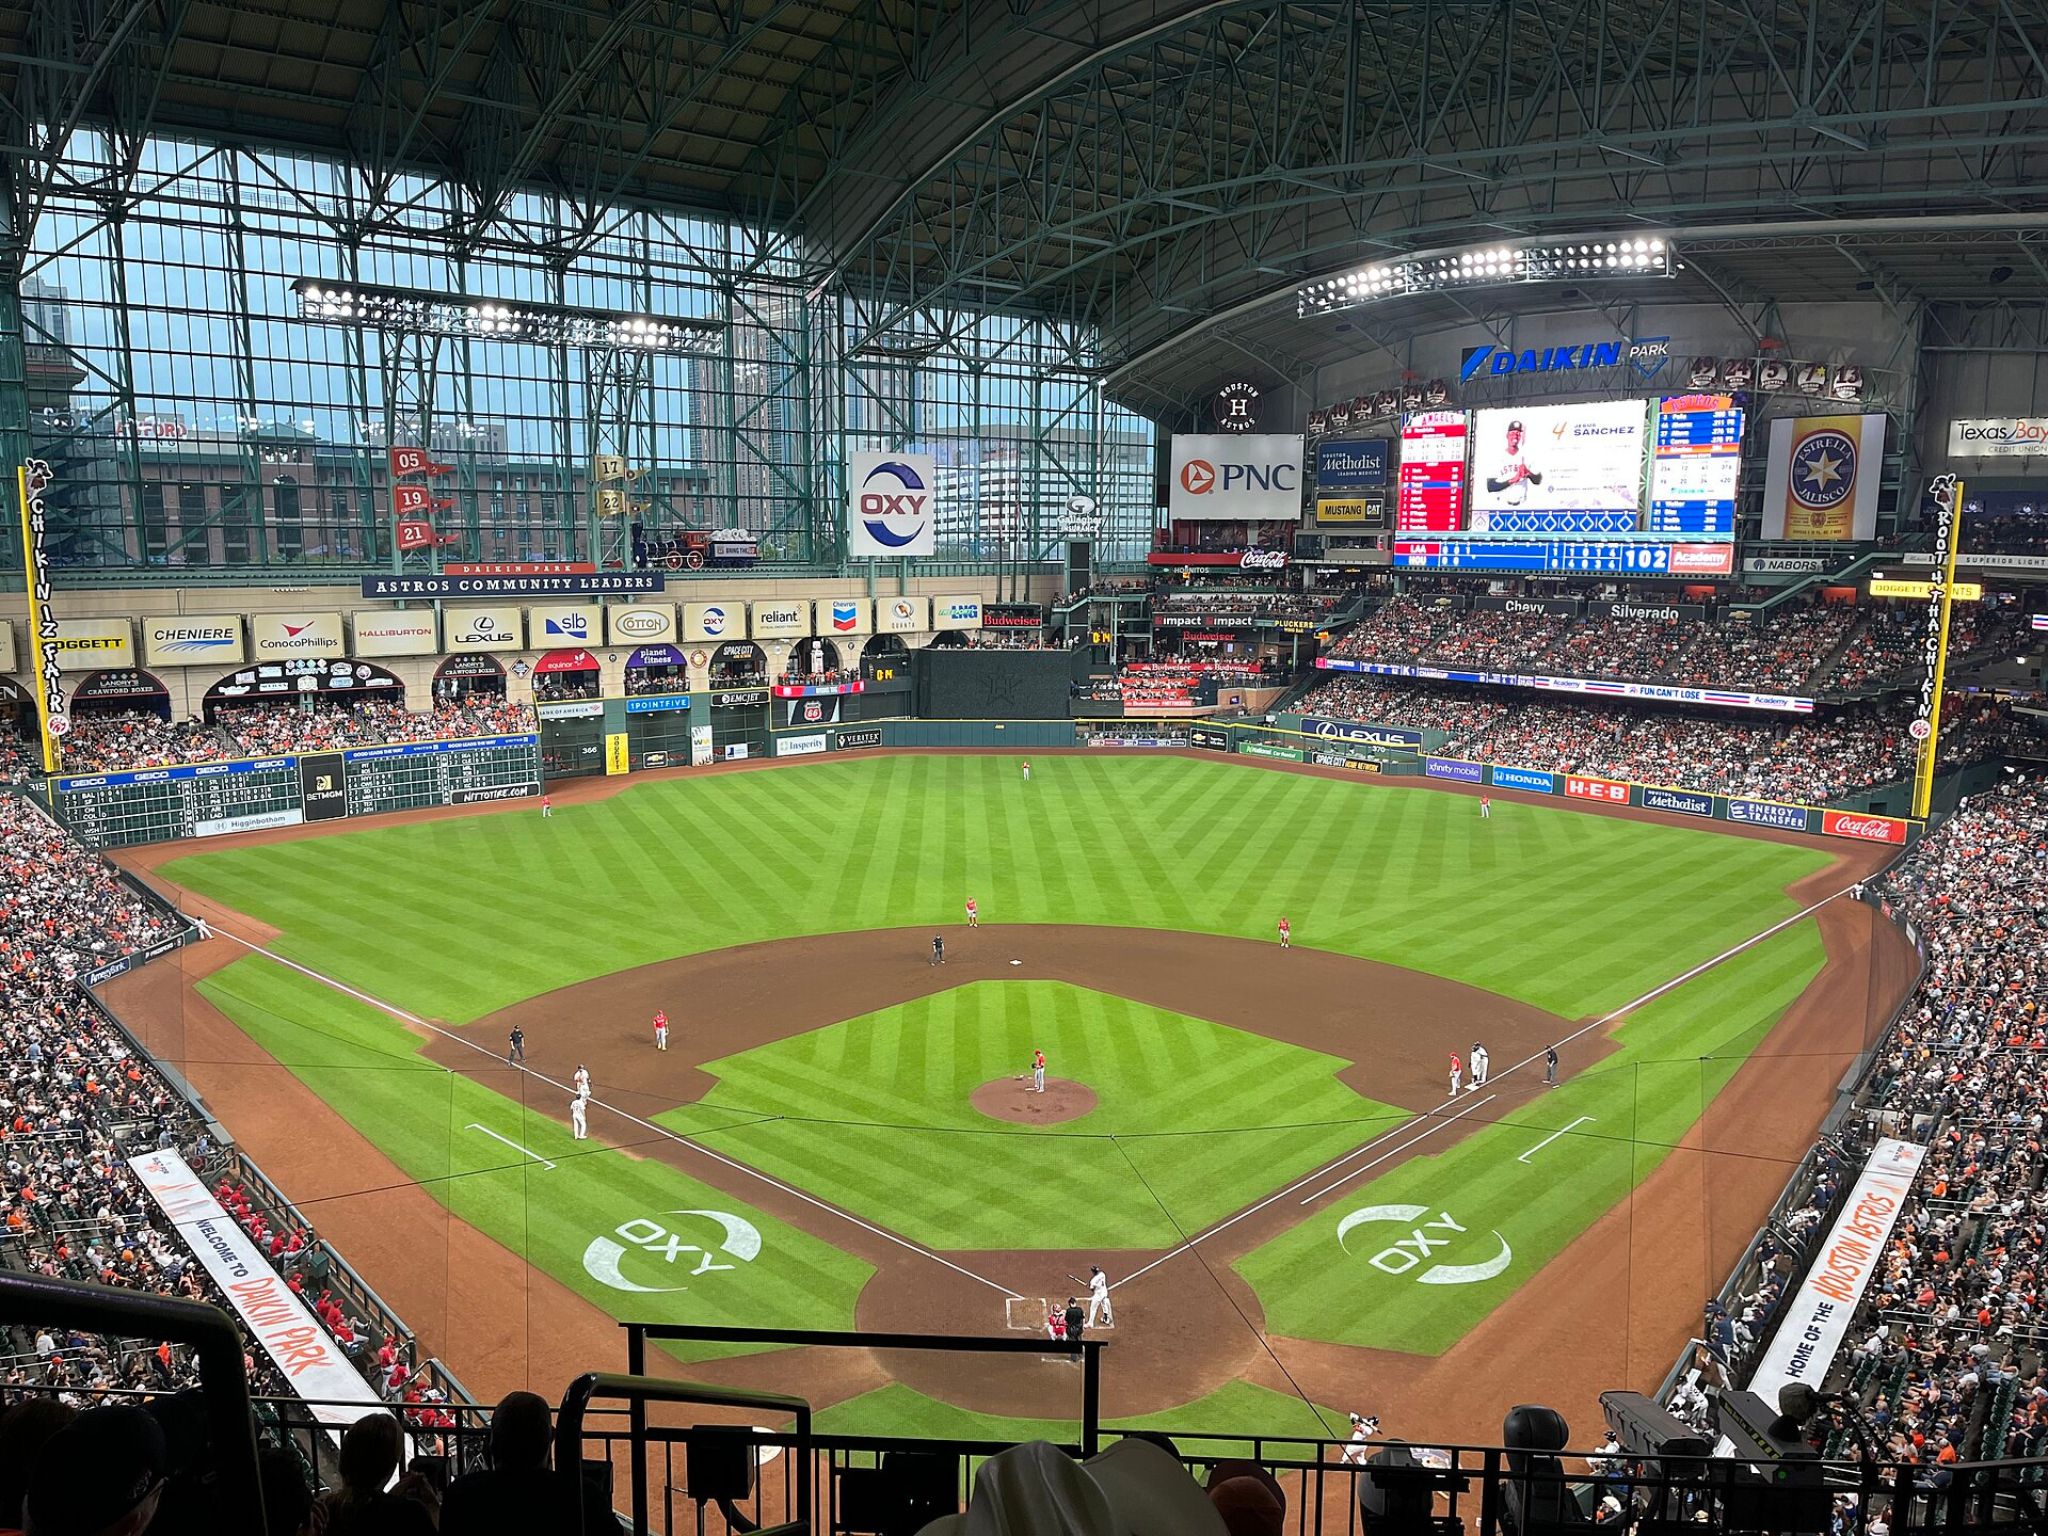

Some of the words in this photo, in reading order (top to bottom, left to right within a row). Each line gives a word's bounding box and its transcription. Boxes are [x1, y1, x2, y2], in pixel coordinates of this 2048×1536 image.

[1490, 342, 1622, 374] DAIKIN
[1630, 343, 1669, 358] PARK
[1725, 358, 1749, 374] 24
[1767, 360, 1779, 378] 5
[1838, 365, 1859, 383] 13
[1220, 382, 1259, 398] HOUSTON
[1377, 390, 1394, 404] 33
[1403, 384, 1420, 399] 34
[1230, 399, 1248, 416] H
[1354, 397, 1370, 411] 25
[1671, 397, 1719, 412] ASTROS
[1220, 417, 1256, 431] ASTROS
[1309, 410, 1324, 425] 32
[1421, 413, 1455, 426] ANGELS
[1552, 421, 1568, 440] 4
[1573, 426, 1635, 436] SANCHEZ
[1958, 423, 2008, 440] Texas
[2016, 422, 2048, 443] Bay
[1798, 438, 1852, 461] ESTRELLA
[399, 453, 419, 468] 05
[602, 461, 618, 474] 17
[1322, 454, 1381, 471] Methodist
[1220, 463, 1296, 491] PNC
[402, 491, 421, 505] 19
[1799, 486, 1845, 502] JALISCO
[603, 497, 619, 509] 22
[860, 494, 927, 515] OXY
[1324, 505, 1362, 515] MUSTANG
[1366, 504, 1380, 515] CAT
[1057, 514, 1102, 525] Gallagher
[404, 526, 423, 541] 21
[1935, 511, 1951, 564] ROOT
[1410, 545, 1426, 554] LAA
[1240, 550, 1288, 569] Coca-Cola
[1409, 556, 1427, 565] HOU
[1673, 552, 1727, 566] Academy
[1768, 560, 1817, 570] NABORS
[463, 565, 522, 573] DAIKIN
[1932, 570, 1943, 584] 4
[376, 580, 450, 593] ASTROS
[460, 578, 572, 591] COMMUNITY
[580, 577, 653, 589] LEADERS
[1875, 585, 1923, 593] DOGGETT
[761, 610, 798, 624] reliant
[951, 604, 978, 620] LNG
[1505, 600, 1545, 615] Chevy
[1611, 605, 1679, 620] Silverado
[1928, 590, 1942, 632] THA
[562, 613, 587, 629] slb
[622, 617, 662, 631] COTTON
[984, 615, 1041, 626] Budweiser
[1163, 616, 1202, 627] impact
[1213, 616, 1252, 627] impact
[1274, 620, 1314, 629] PLUCKERS
[155, 628, 233, 641] CHENIERE
[359, 629, 432, 637] HALLIBURTON
[455, 633, 513, 643] LEXUS
[1183, 632, 1236, 641] Budweiser
[260, 638, 338, 649] ConocoPhillips
[723, 646, 743, 656] SPACE
[741, 645, 754, 654] CITY
[640, 649, 667, 659] planet
[644, 655, 672, 664] fitness
[445, 668, 477, 676] CRAWFORD
[1152, 663, 1191, 671] Budweiser
[1214, 663, 1250, 672] Budweiser
[44, 643, 63, 712] FAIR
[99, 679, 139, 687] LANDRY'S
[1918, 637, 1938, 717] CHIKIN
[87, 687, 128, 696] CRAWFORD
[131, 686, 154, 694] BOXES
[730, 692, 760, 703] EMCJET
[1553, 679, 1580, 688] Academy
[1640, 687, 1655, 696] FUN
[1657, 688, 1680, 697] CAN'T
[1680, 689, 1700, 699] LOSE
[1754, 696, 1788, 707] Academy
[563, 707, 589, 715] AMERICA
[630, 698, 686, 710] 1POINTFIVE
[807, 709, 819, 718] 66
[847, 733, 879, 742] VERITEX
[1340, 729, 1405, 744] LEXUS
[789, 737, 823, 751] Insperity
[254, 760, 286, 769] GEICO
[1316, 754, 1333, 766] SPACE
[1331, 756, 1346, 767] CITY
[134, 771, 170, 781] GEICO
[195, 766, 229, 775] GEICO
[1429, 762, 1453, 775] xfinity
[1454, 766, 1480, 777] mobile
[28, 782, 47, 791] 315
[70, 777, 107, 787] GEICO
[1505, 774, 1551, 787] HONDA
[306, 790, 343, 801] BETMGM
[463, 786, 528, 802] NITTOTIRE.COM
[1648, 795, 1708, 813] Methodist
[1749, 803, 1793, 816] ENERGY
[231, 816, 286, 828] Higginbotham
[1749, 814, 1803, 827] TRANSFER
[1835, 816, 1892, 838] Coca-Cola
[90, 961, 126, 984] AmegyBank
[195, 1218, 240, 1265] WELCOME
[230, 1261, 250, 1278] TO
[614, 1218, 736, 1276] OXY
[1368, 1211, 1468, 1275] OXY
[1809, 1232, 1873, 1303] HOUSTON
[1843, 1192, 1895, 1242] ASTROS
[228, 1276, 301, 1328] DAIKIN
[1785, 1341, 1814, 1378] HOME
[1807, 1324, 1823, 1347] OF
[1817, 1301, 1835, 1326] THE
[264, 1326, 337, 1378] PARK
